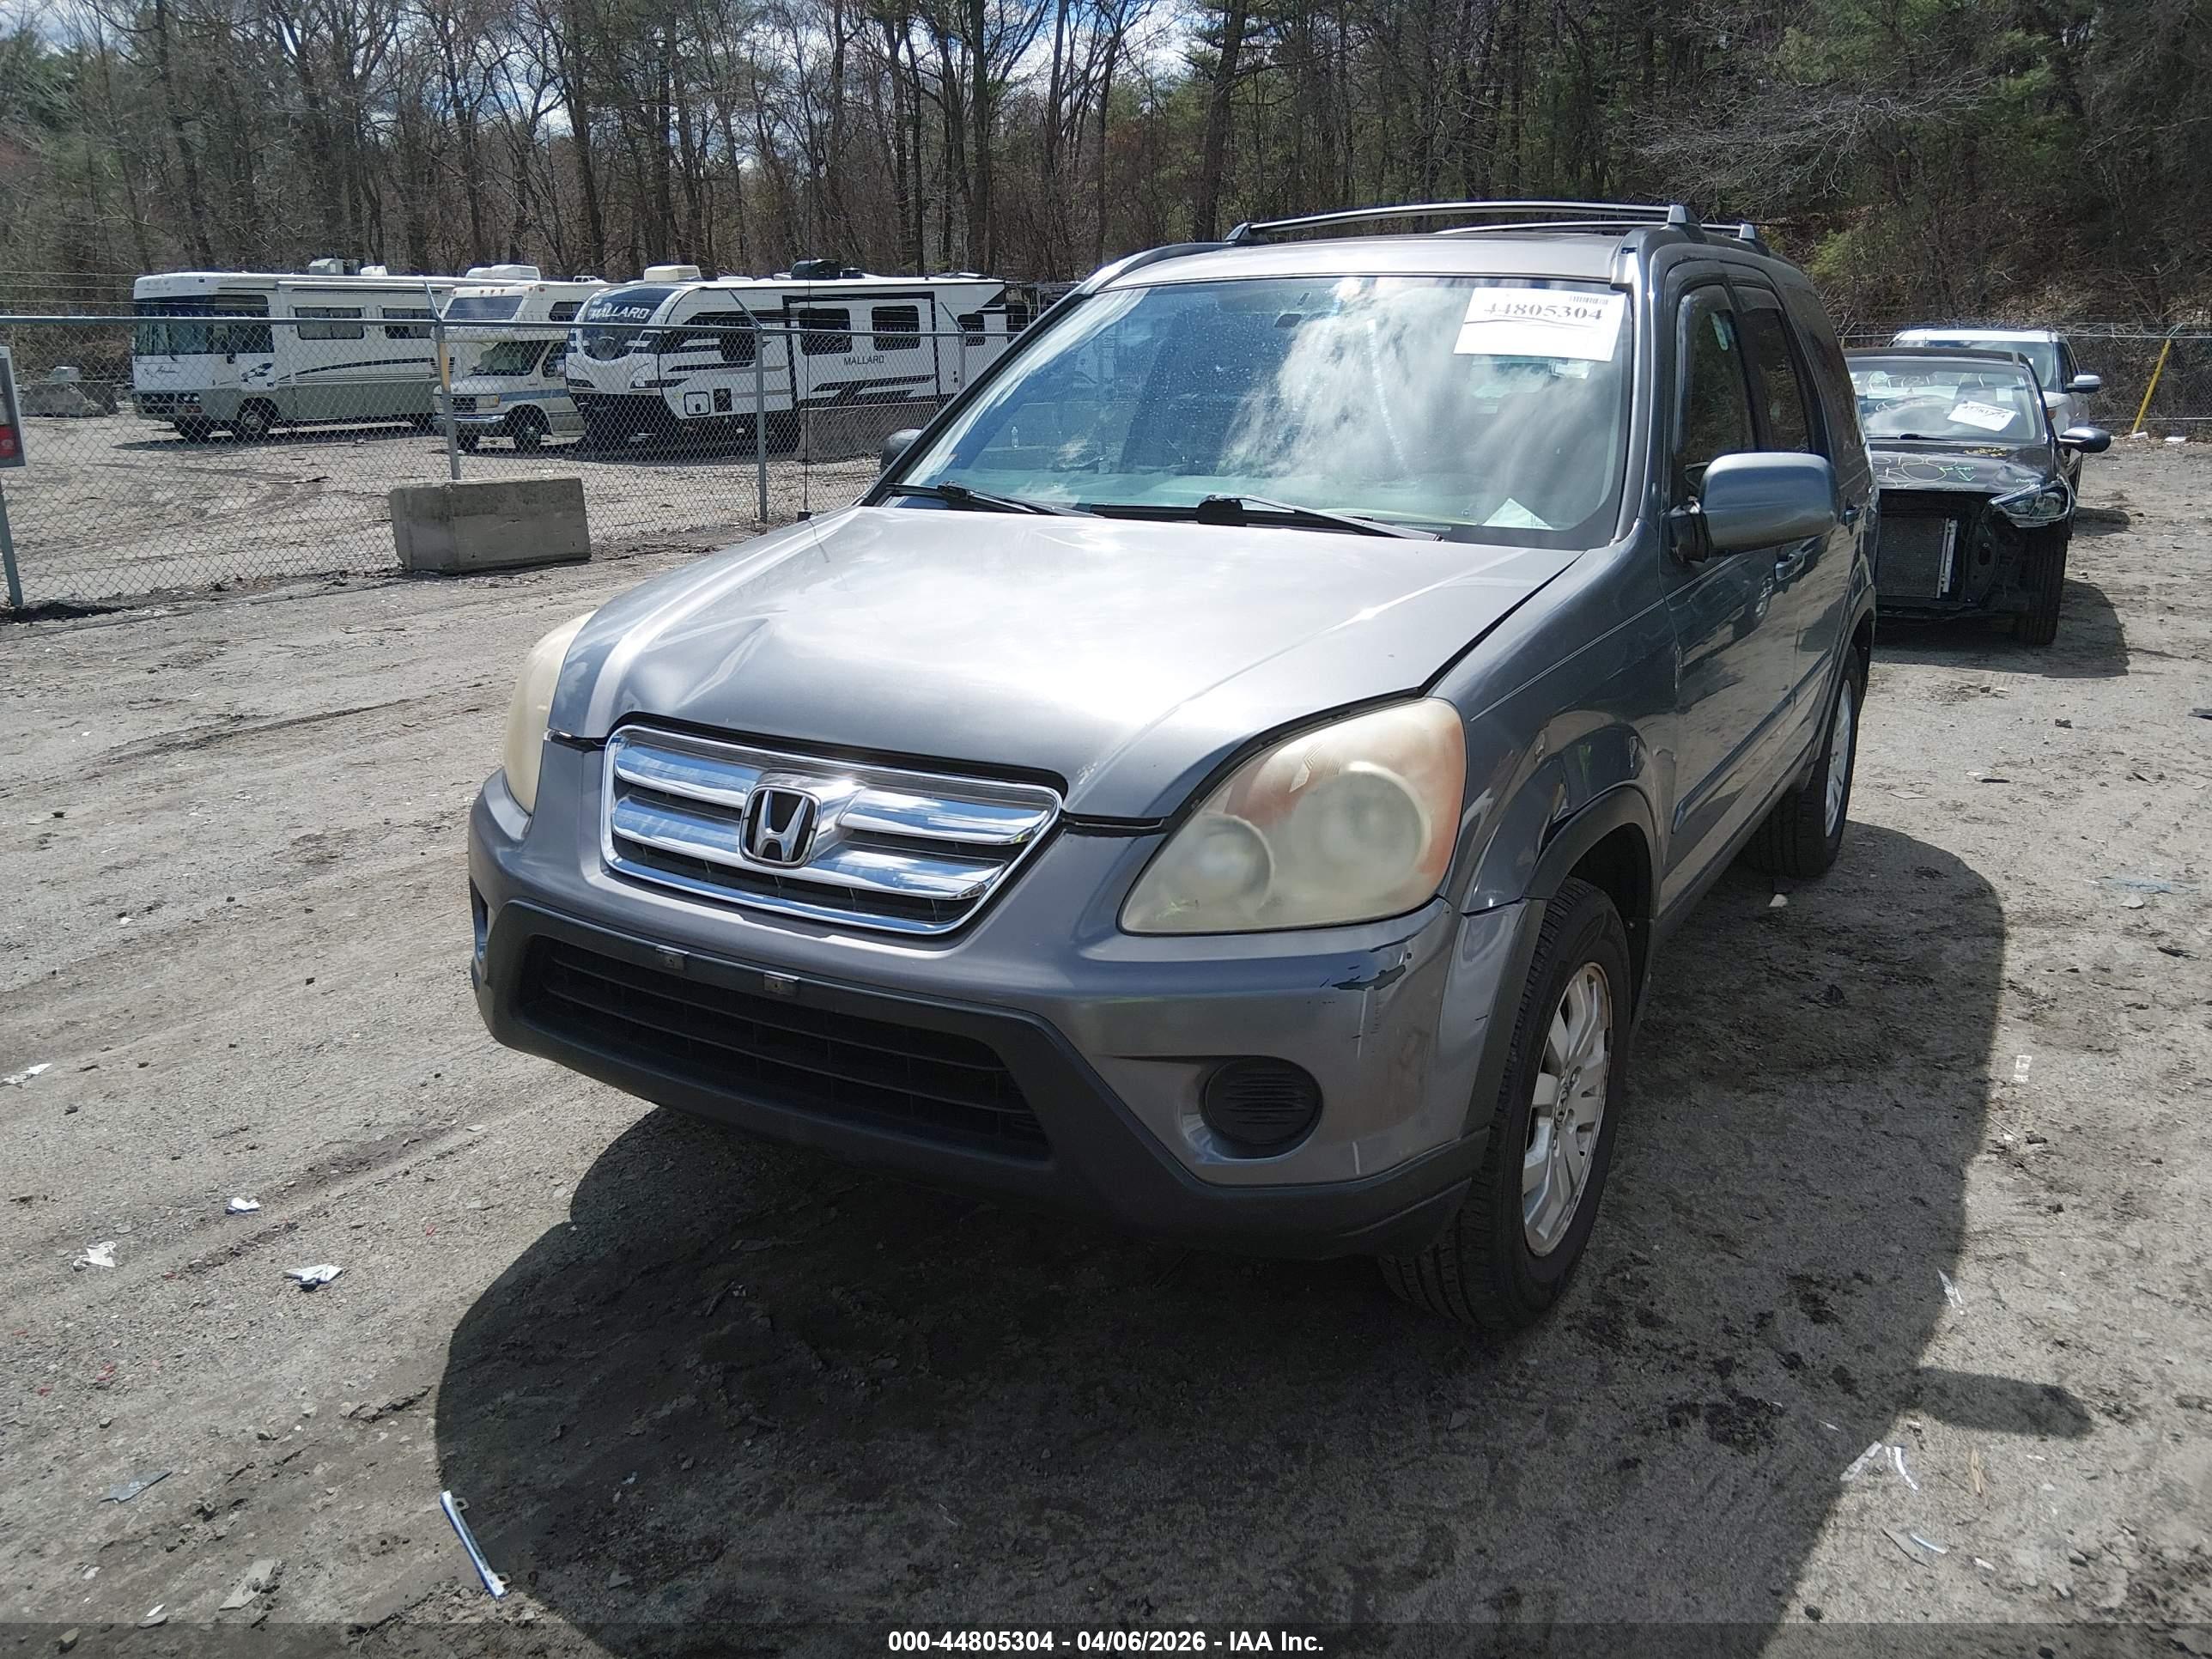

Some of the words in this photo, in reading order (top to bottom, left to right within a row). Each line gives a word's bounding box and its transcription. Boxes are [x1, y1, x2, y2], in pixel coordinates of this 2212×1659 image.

[588, 305, 650, 319] MALLARD
[1484, 302, 1603, 320] 44805304
[843, 355, 884, 366] MALLARD
